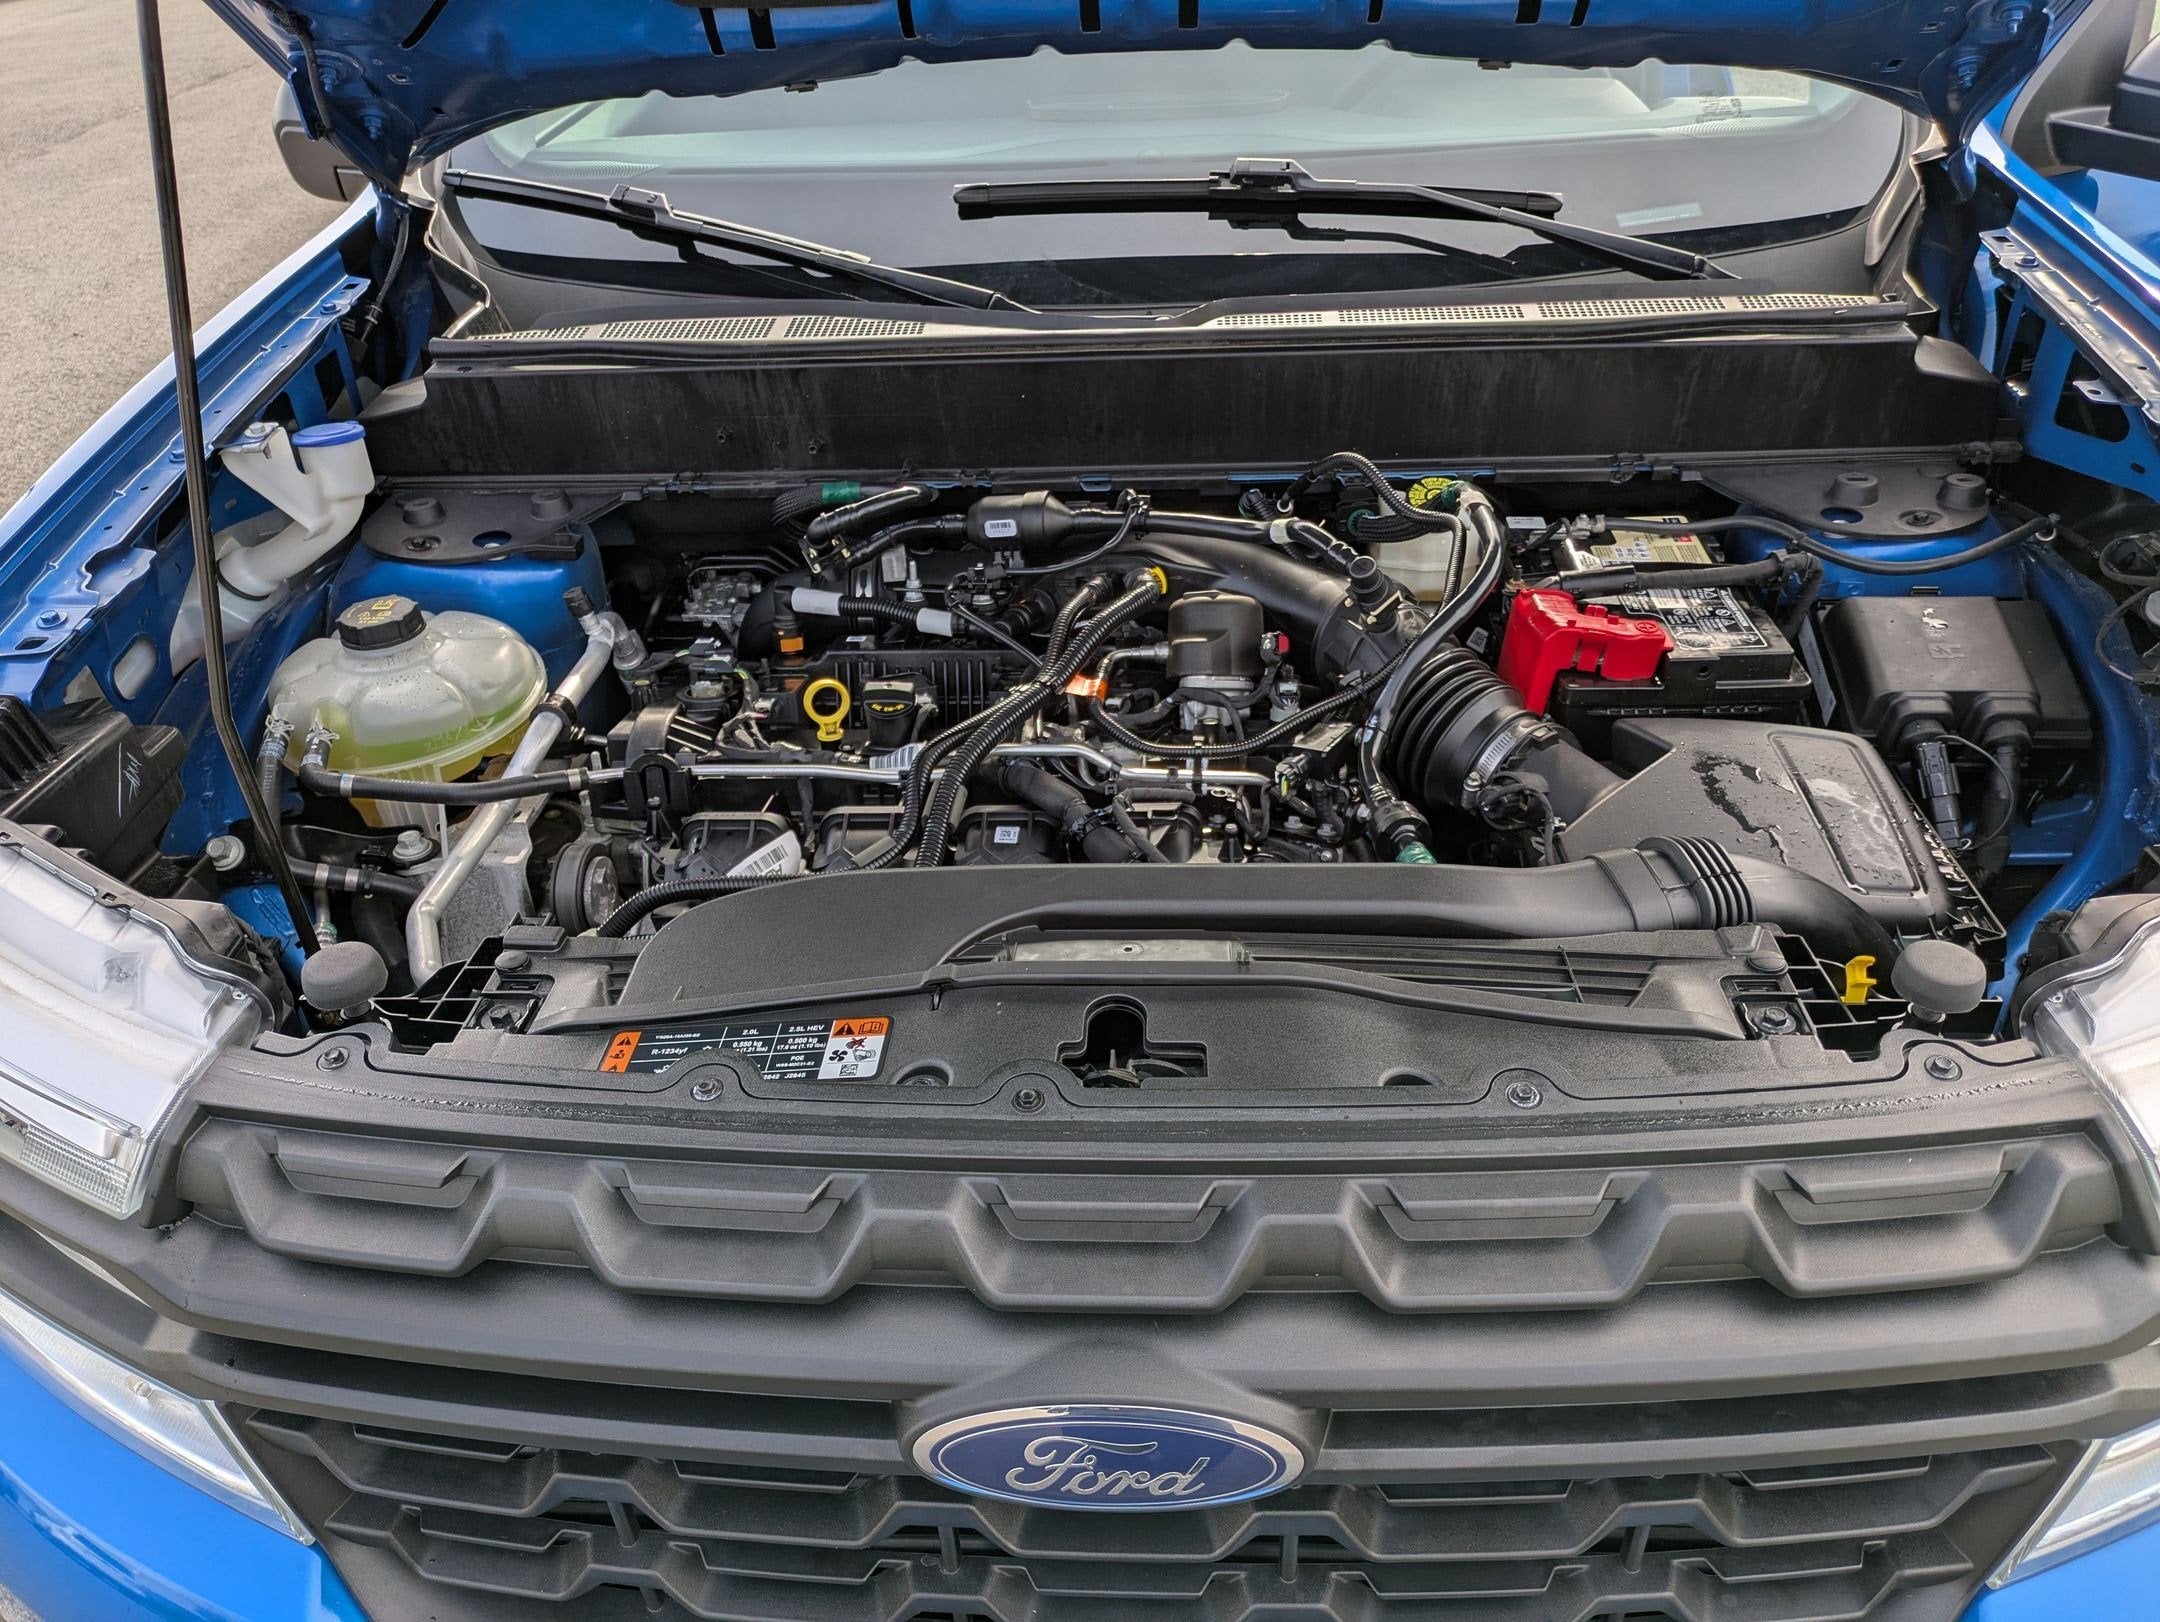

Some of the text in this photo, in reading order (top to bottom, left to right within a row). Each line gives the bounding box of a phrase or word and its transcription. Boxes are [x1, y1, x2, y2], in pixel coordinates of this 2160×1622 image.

[753, 1040, 763, 1048] kg
[651, 1047, 689, 1055] R-1234yf
[1005, 1436, 1210, 1497] Ford
